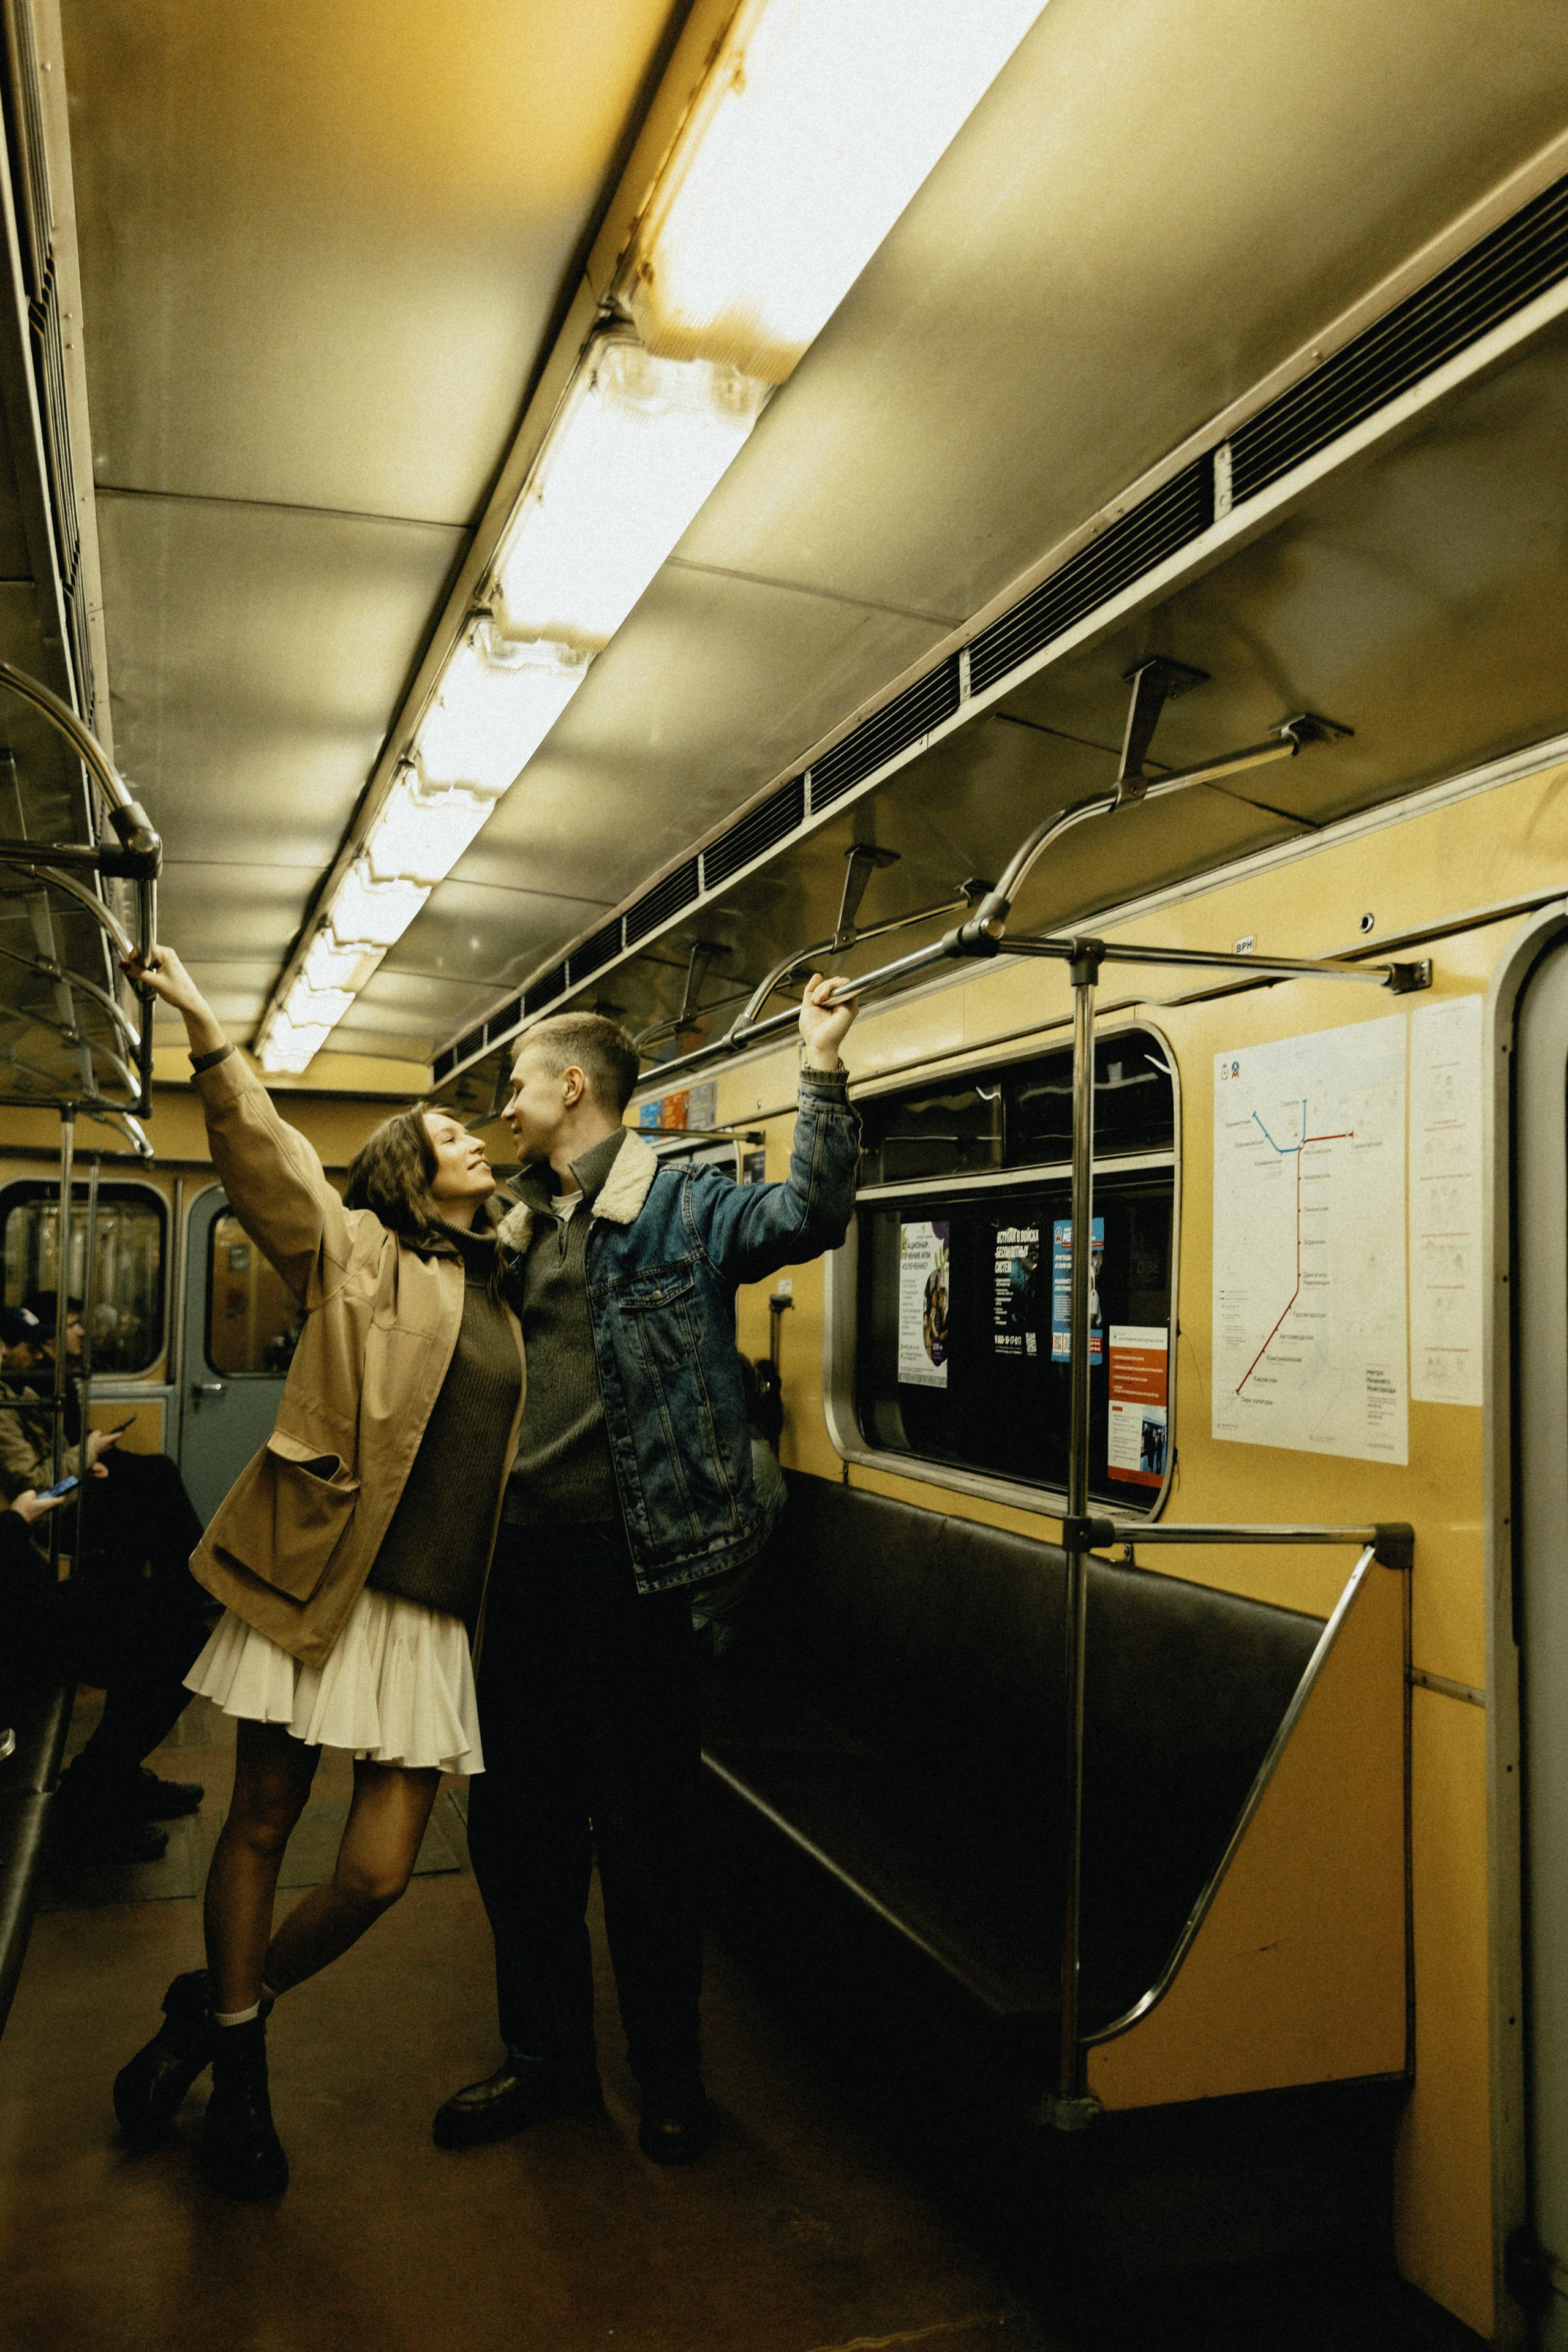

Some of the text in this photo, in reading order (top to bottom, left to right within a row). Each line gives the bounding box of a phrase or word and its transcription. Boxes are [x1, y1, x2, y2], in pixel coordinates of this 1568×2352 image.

[997, 1227, 1039, 1244] ВСТУПАЙ В ВОЙСКА
[995, 1245, 1029, 1259] БЕСПИЛОТНЫХ
[995, 1261, 1012, 1273] СИСТЕМ
